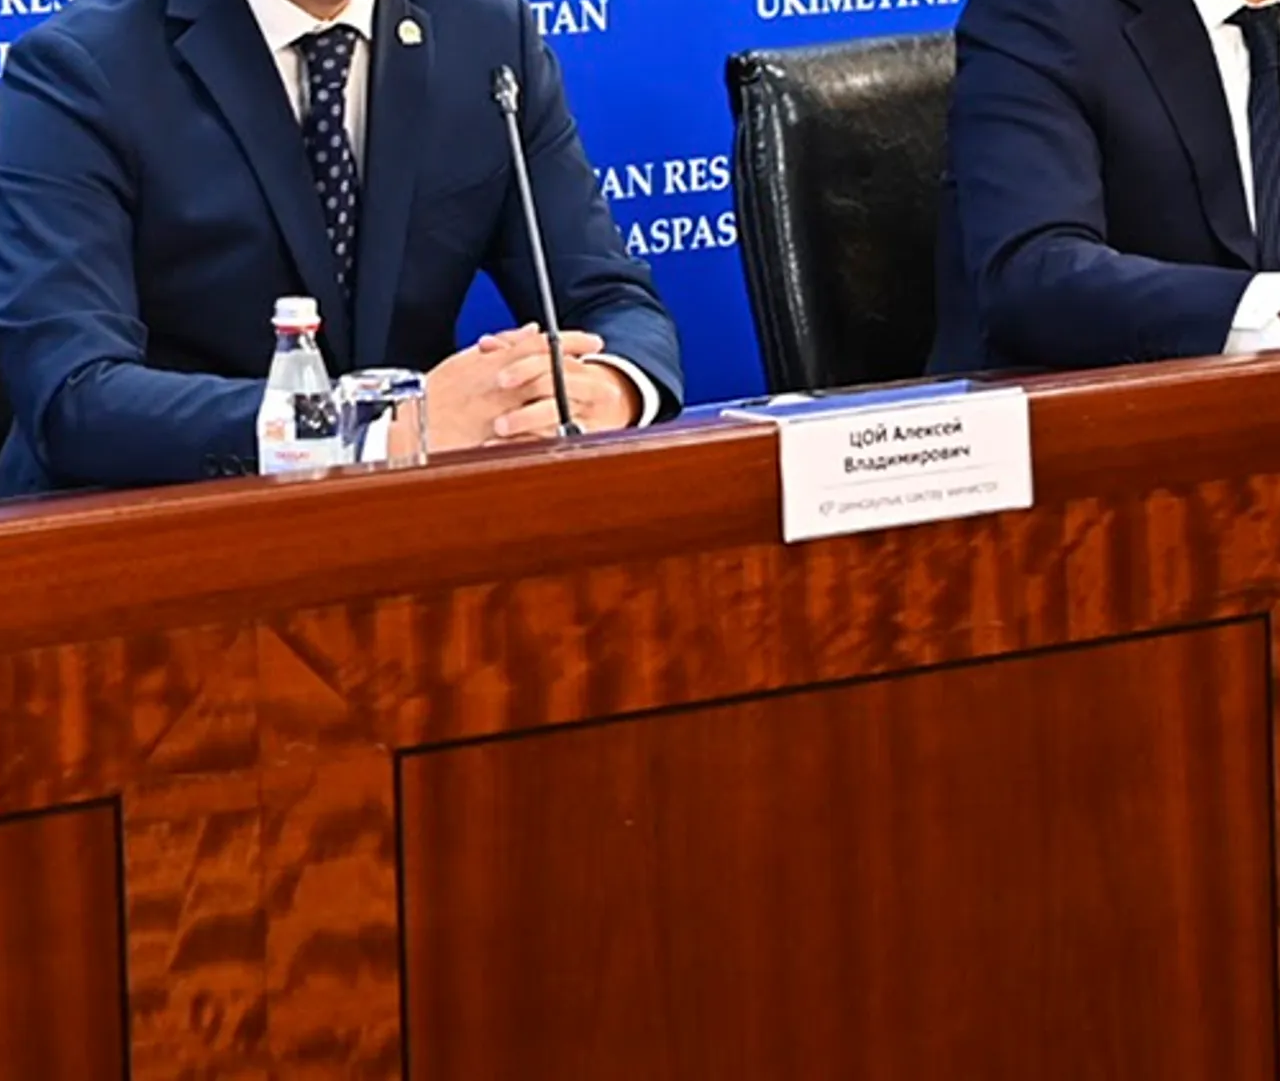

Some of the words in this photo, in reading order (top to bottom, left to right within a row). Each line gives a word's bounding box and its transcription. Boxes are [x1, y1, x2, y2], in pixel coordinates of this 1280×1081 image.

[614, 210, 738, 256] ASPAS
[849, 423, 888, 449] ЦОЙ
[893, 417, 964, 441] Алексей
[843, 445, 971, 474] Владимирович
